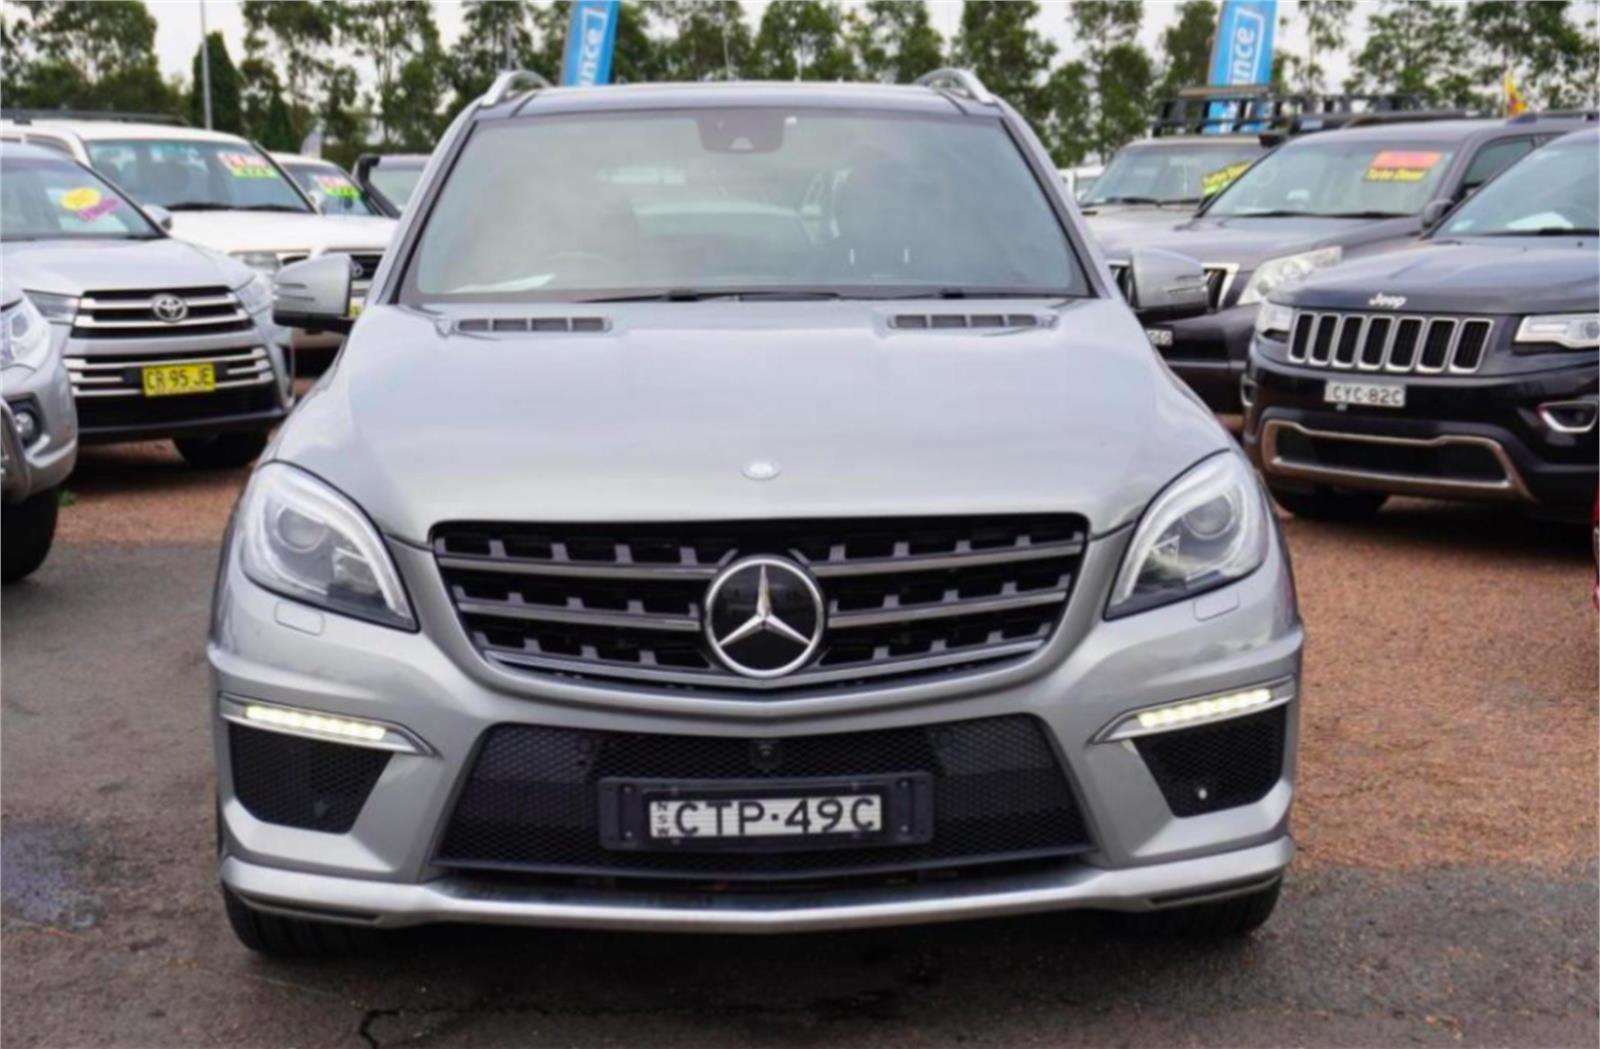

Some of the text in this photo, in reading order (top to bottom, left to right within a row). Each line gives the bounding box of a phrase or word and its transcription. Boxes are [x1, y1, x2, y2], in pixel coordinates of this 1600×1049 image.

[580, 28, 602, 85] nce
[1368, 292, 1407, 309] Jeep
[146, 366, 213, 390] CR 95 JE
